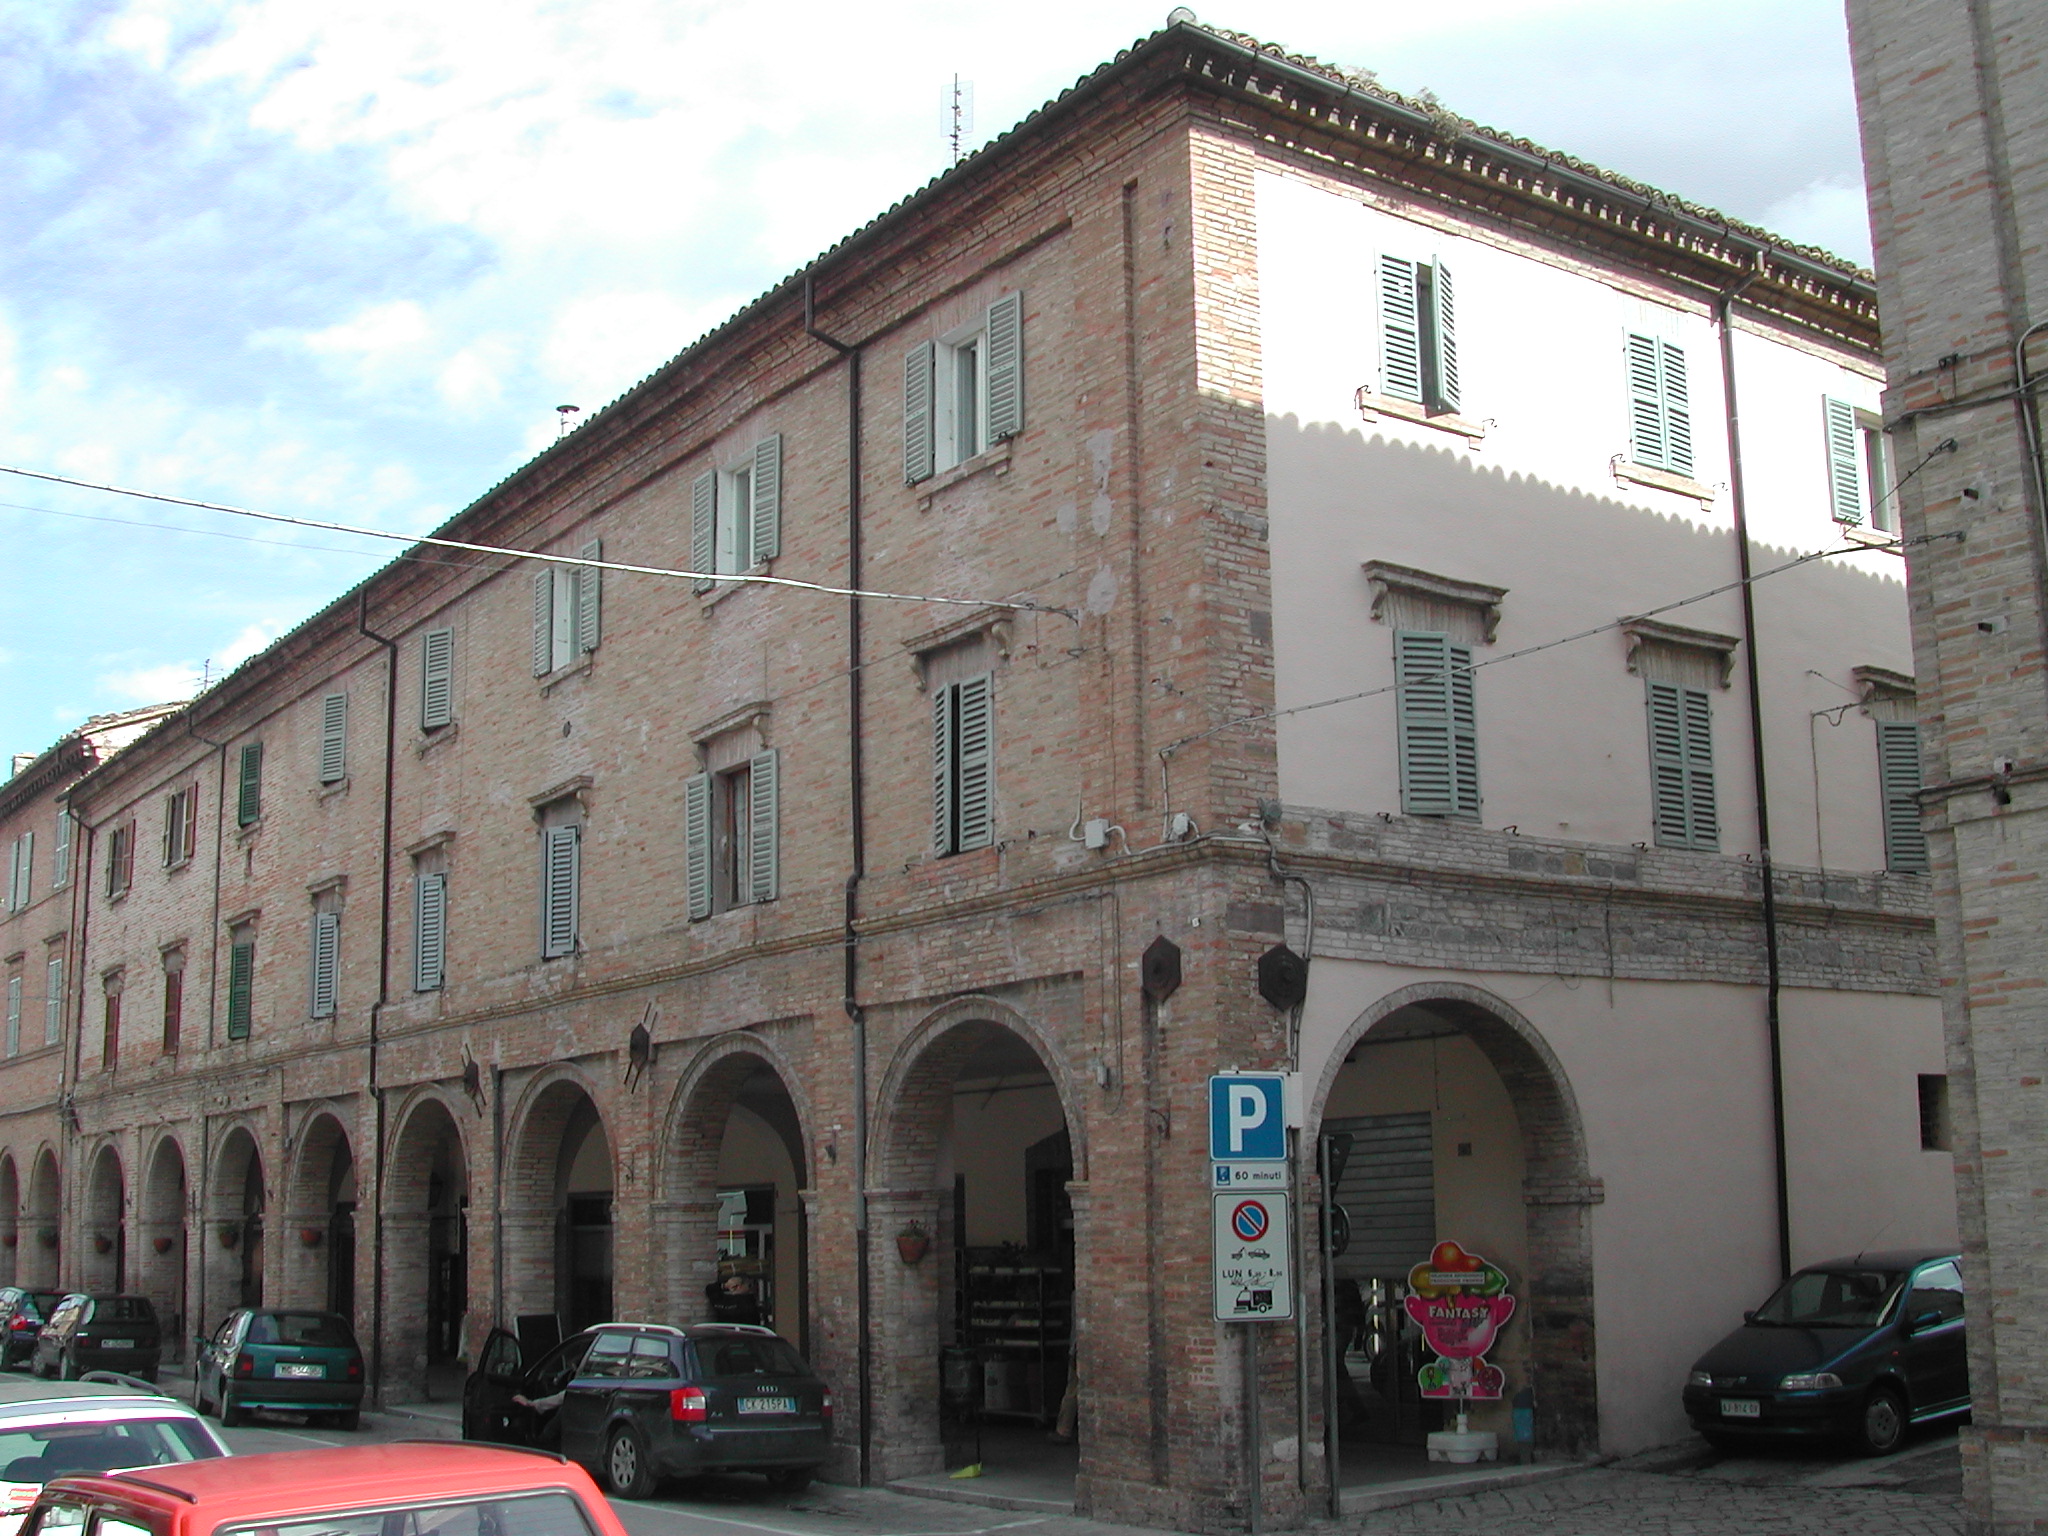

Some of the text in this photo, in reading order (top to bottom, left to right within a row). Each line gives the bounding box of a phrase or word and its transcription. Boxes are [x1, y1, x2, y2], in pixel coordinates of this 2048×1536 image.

[1229, 1084, 1267, 1152] P
[1235, 1170, 1281, 1180] 60 minuti
[1222, 1269, 1242, 1278] LUN
[1429, 1305, 1489, 1319] FANTASY
